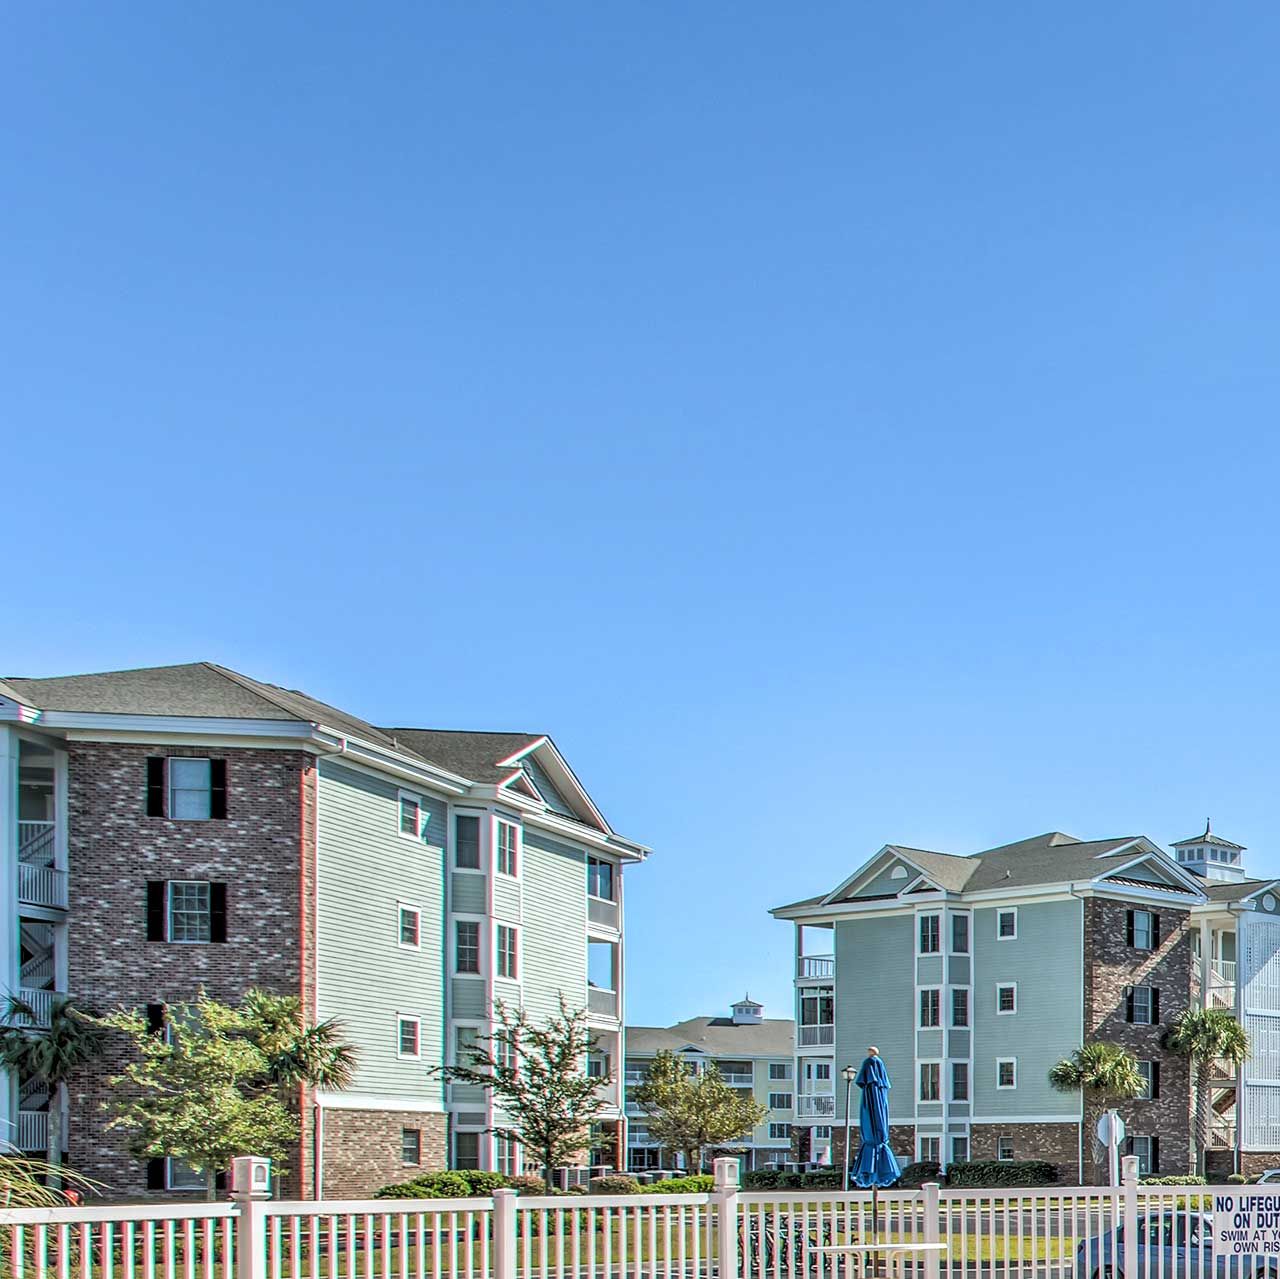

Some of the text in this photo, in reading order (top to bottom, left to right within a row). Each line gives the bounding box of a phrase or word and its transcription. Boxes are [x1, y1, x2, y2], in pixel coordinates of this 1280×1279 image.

[1216, 1195, 1234, 1212] NO
[1233, 1213, 1251, 1229] ON
[1220, 1230, 1248, 1241] SWIM
[1253, 1230, 1267, 1241] AT
[1233, 1242, 1259, 1253] OWN
